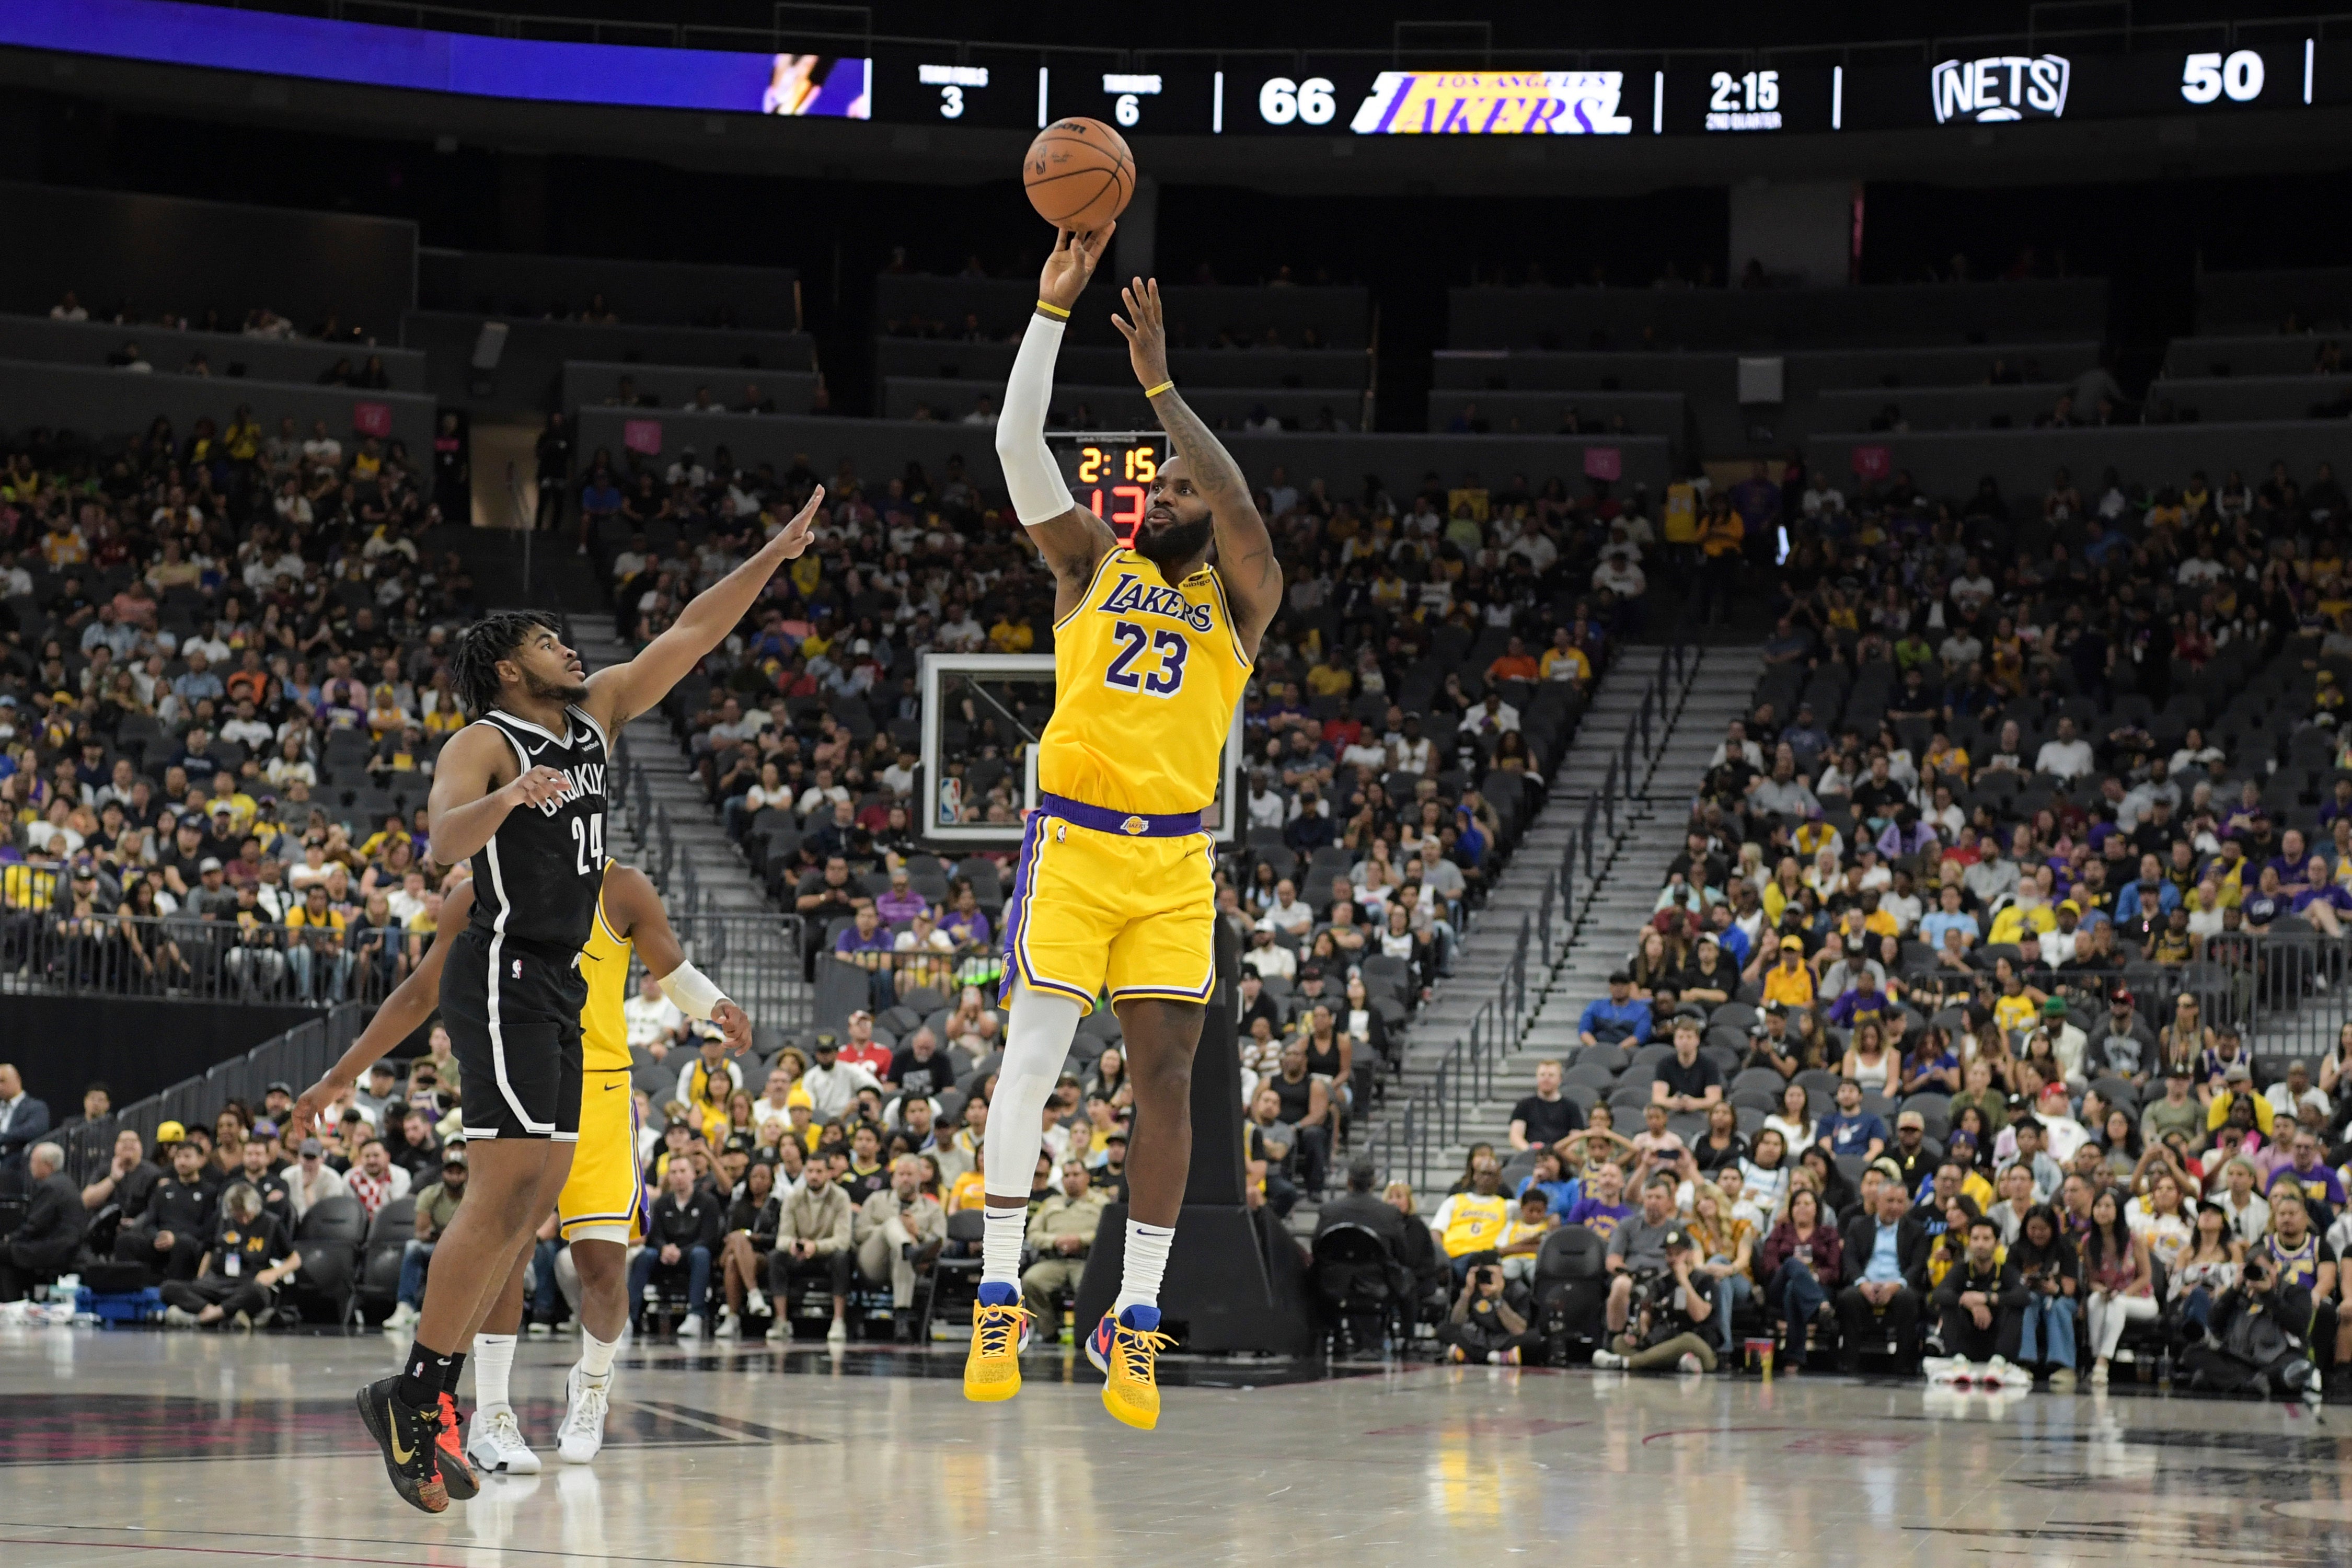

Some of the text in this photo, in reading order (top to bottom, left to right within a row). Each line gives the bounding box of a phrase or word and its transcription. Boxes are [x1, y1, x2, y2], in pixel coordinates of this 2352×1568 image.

[1437, 74, 1606, 87] LOS ANGELES
[1711, 71, 1779, 111] 2:15
[1943, 56, 2059, 118] NETS
[2182, 50, 2264, 103] 50
[940, 85, 964, 118] 3
[1116, 94, 1139, 126] 6
[1259, 77, 1336, 124] 66
[1374, 76, 1603, 133] LAKERS
[1079, 447, 1157, 483] 2:15
[1097, 573, 1214, 632] LAKERS
[1183, 579, 1210, 587] bibigo
[1104, 620, 1189, 699] 23
[571, 813, 604, 875] 24
